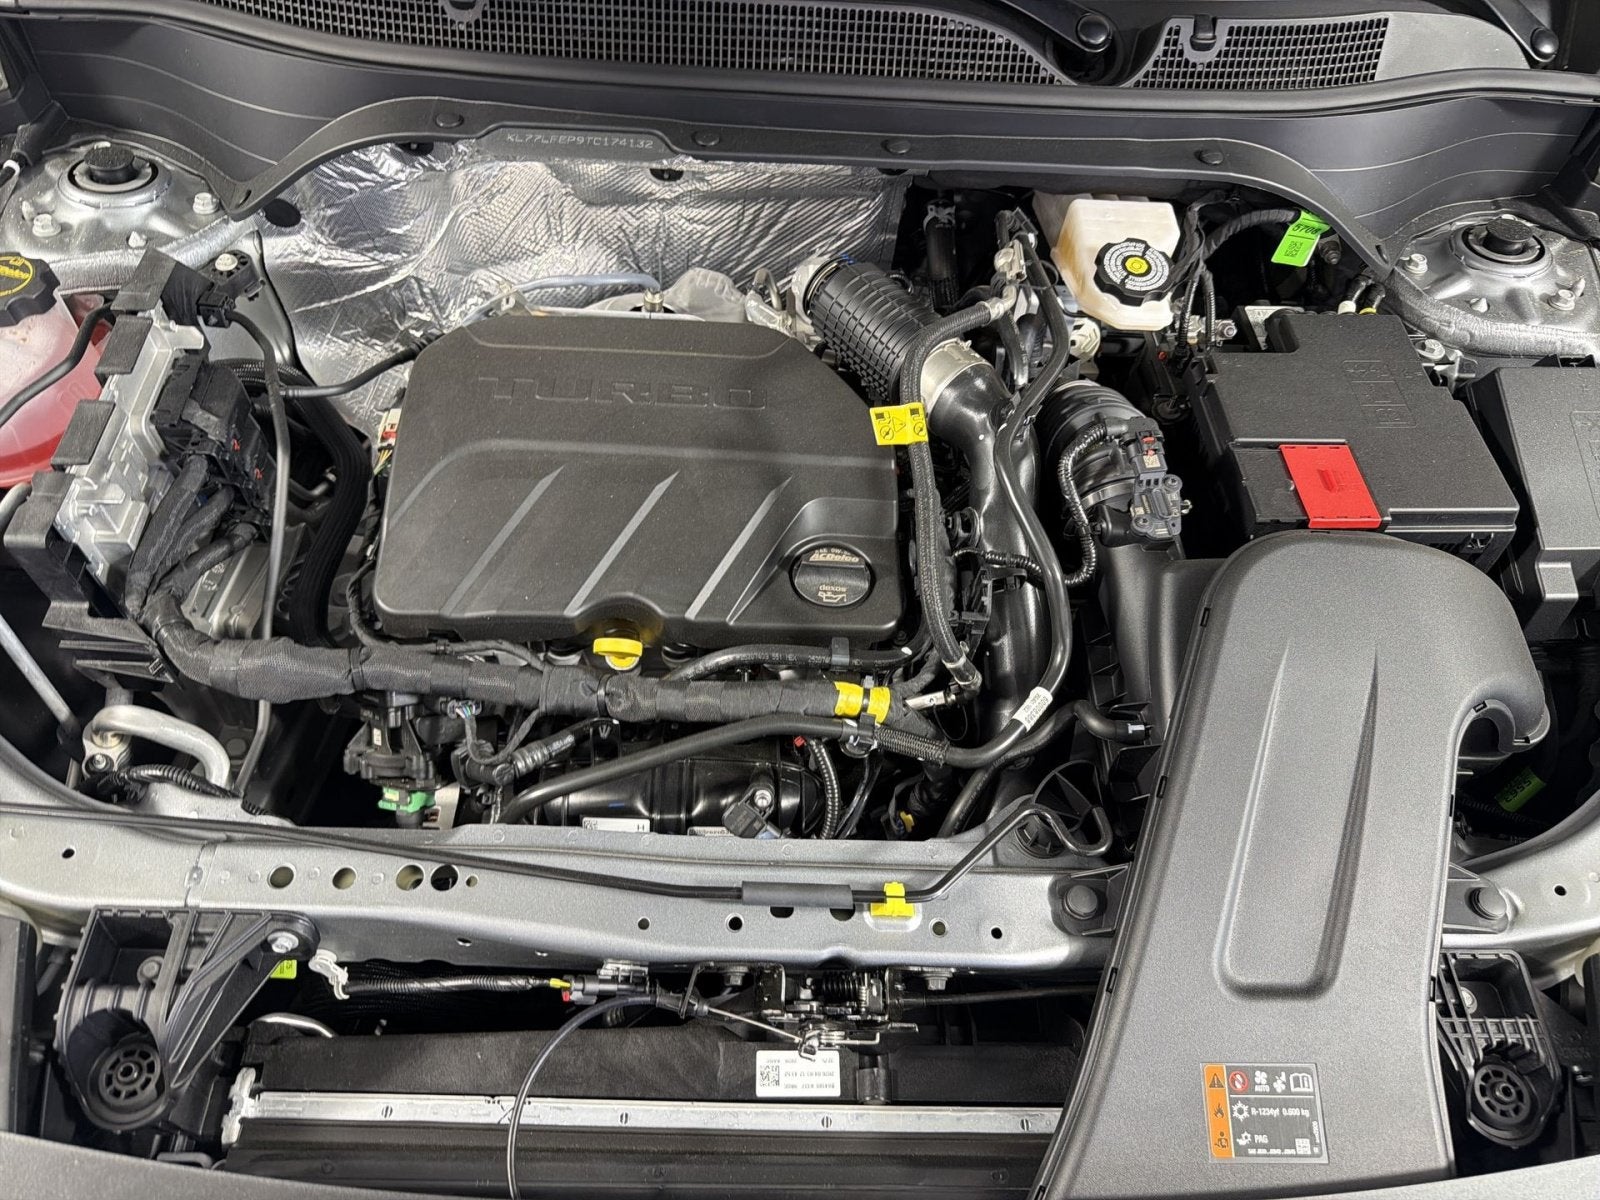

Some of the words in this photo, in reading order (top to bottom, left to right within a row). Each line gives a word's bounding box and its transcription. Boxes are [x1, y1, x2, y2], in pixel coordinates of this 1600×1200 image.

[478, 376, 767, 410] TURBO
[809, 552, 860, 563] ACDelco
[819, 584, 847, 592] dexos
[1254, 1084, 1270, 1093] AUTO
[1250, 1107, 1280, 1118] R-1234yf
[1301, 1107, 1310, 1118] kg
[1254, 1134, 1269, 1144] PAG
